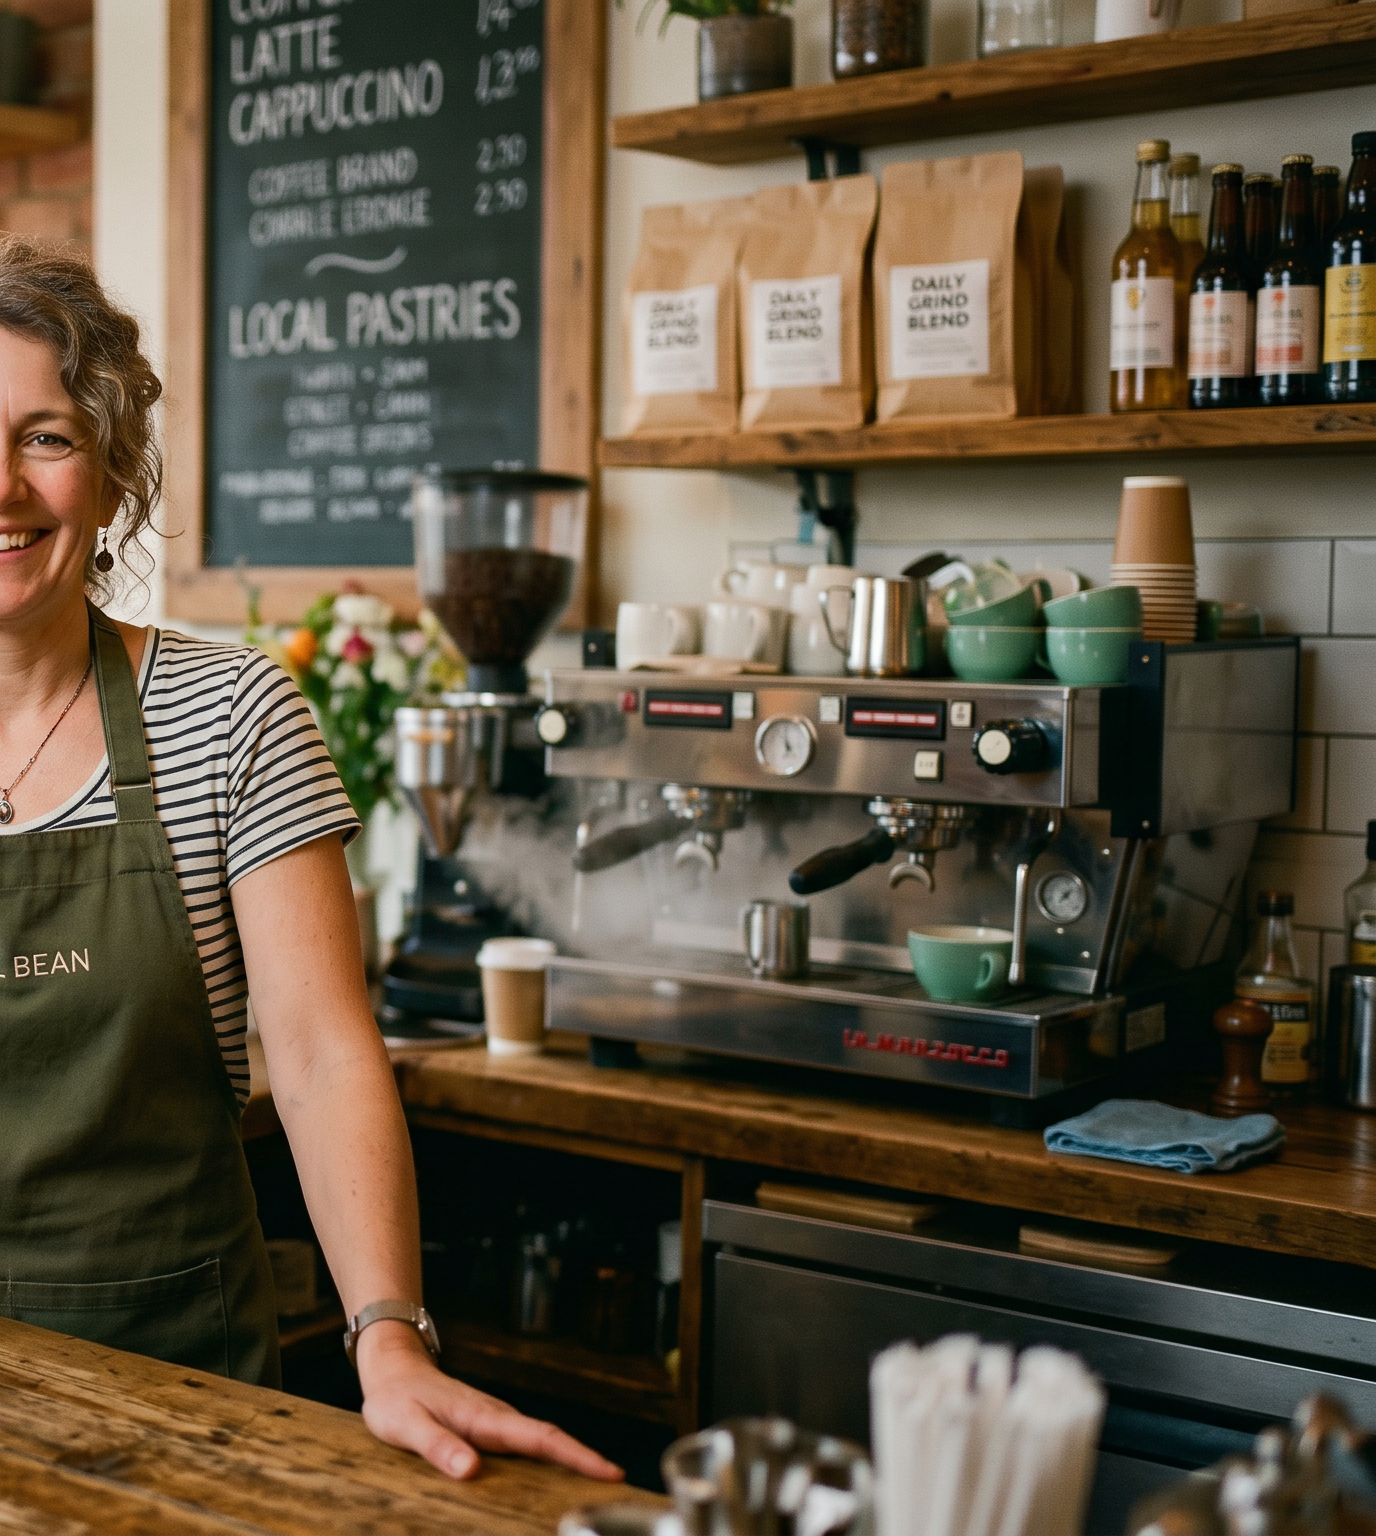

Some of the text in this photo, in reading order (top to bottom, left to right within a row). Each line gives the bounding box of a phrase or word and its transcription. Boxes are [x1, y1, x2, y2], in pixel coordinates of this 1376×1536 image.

[230, 14, 343, 86] LATTE
[228, 58, 444, 146] CAPPUCCINO
[911, 273, 966, 292] DAILY
[908, 292, 969, 311] GRIND
[228, 277, 521, 358] LOCAL PASTRIES
[908, 312, 969, 331] BLEND
[14, 948, 90, 978] BEAN
